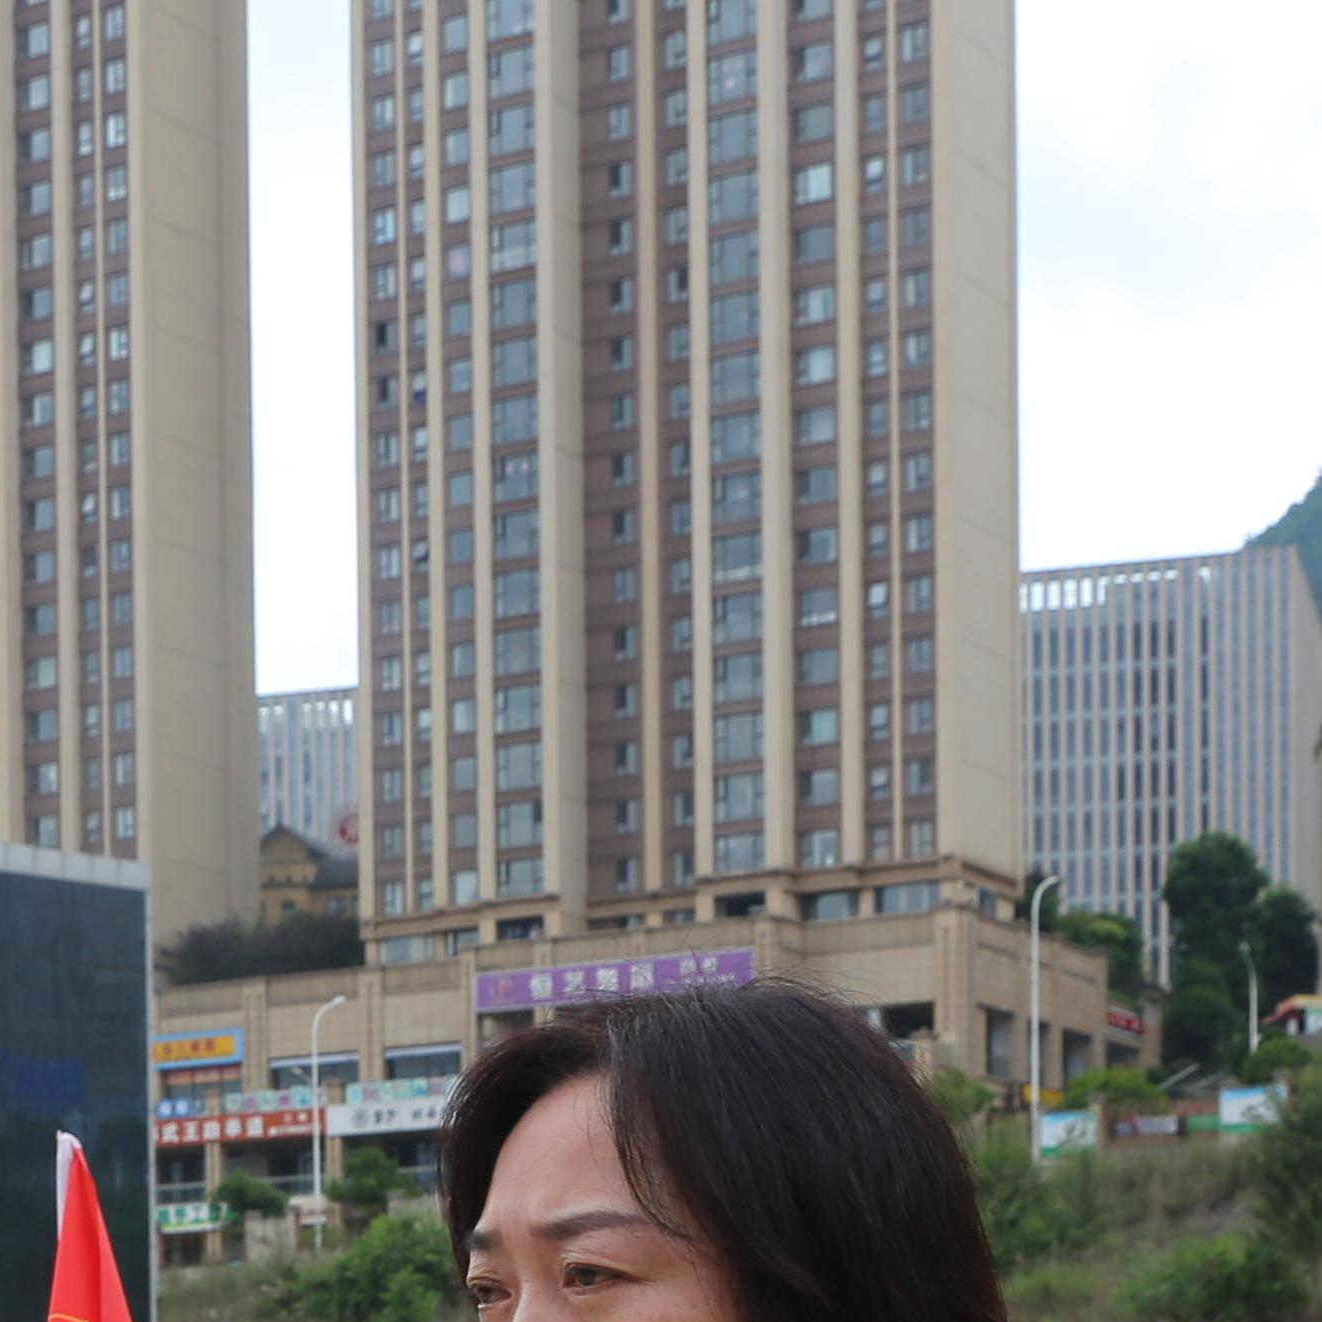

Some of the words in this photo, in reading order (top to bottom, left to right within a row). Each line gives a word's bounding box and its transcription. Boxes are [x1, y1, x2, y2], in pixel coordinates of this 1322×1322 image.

[154, 1115, 265, 1145] 武王跆拳道
